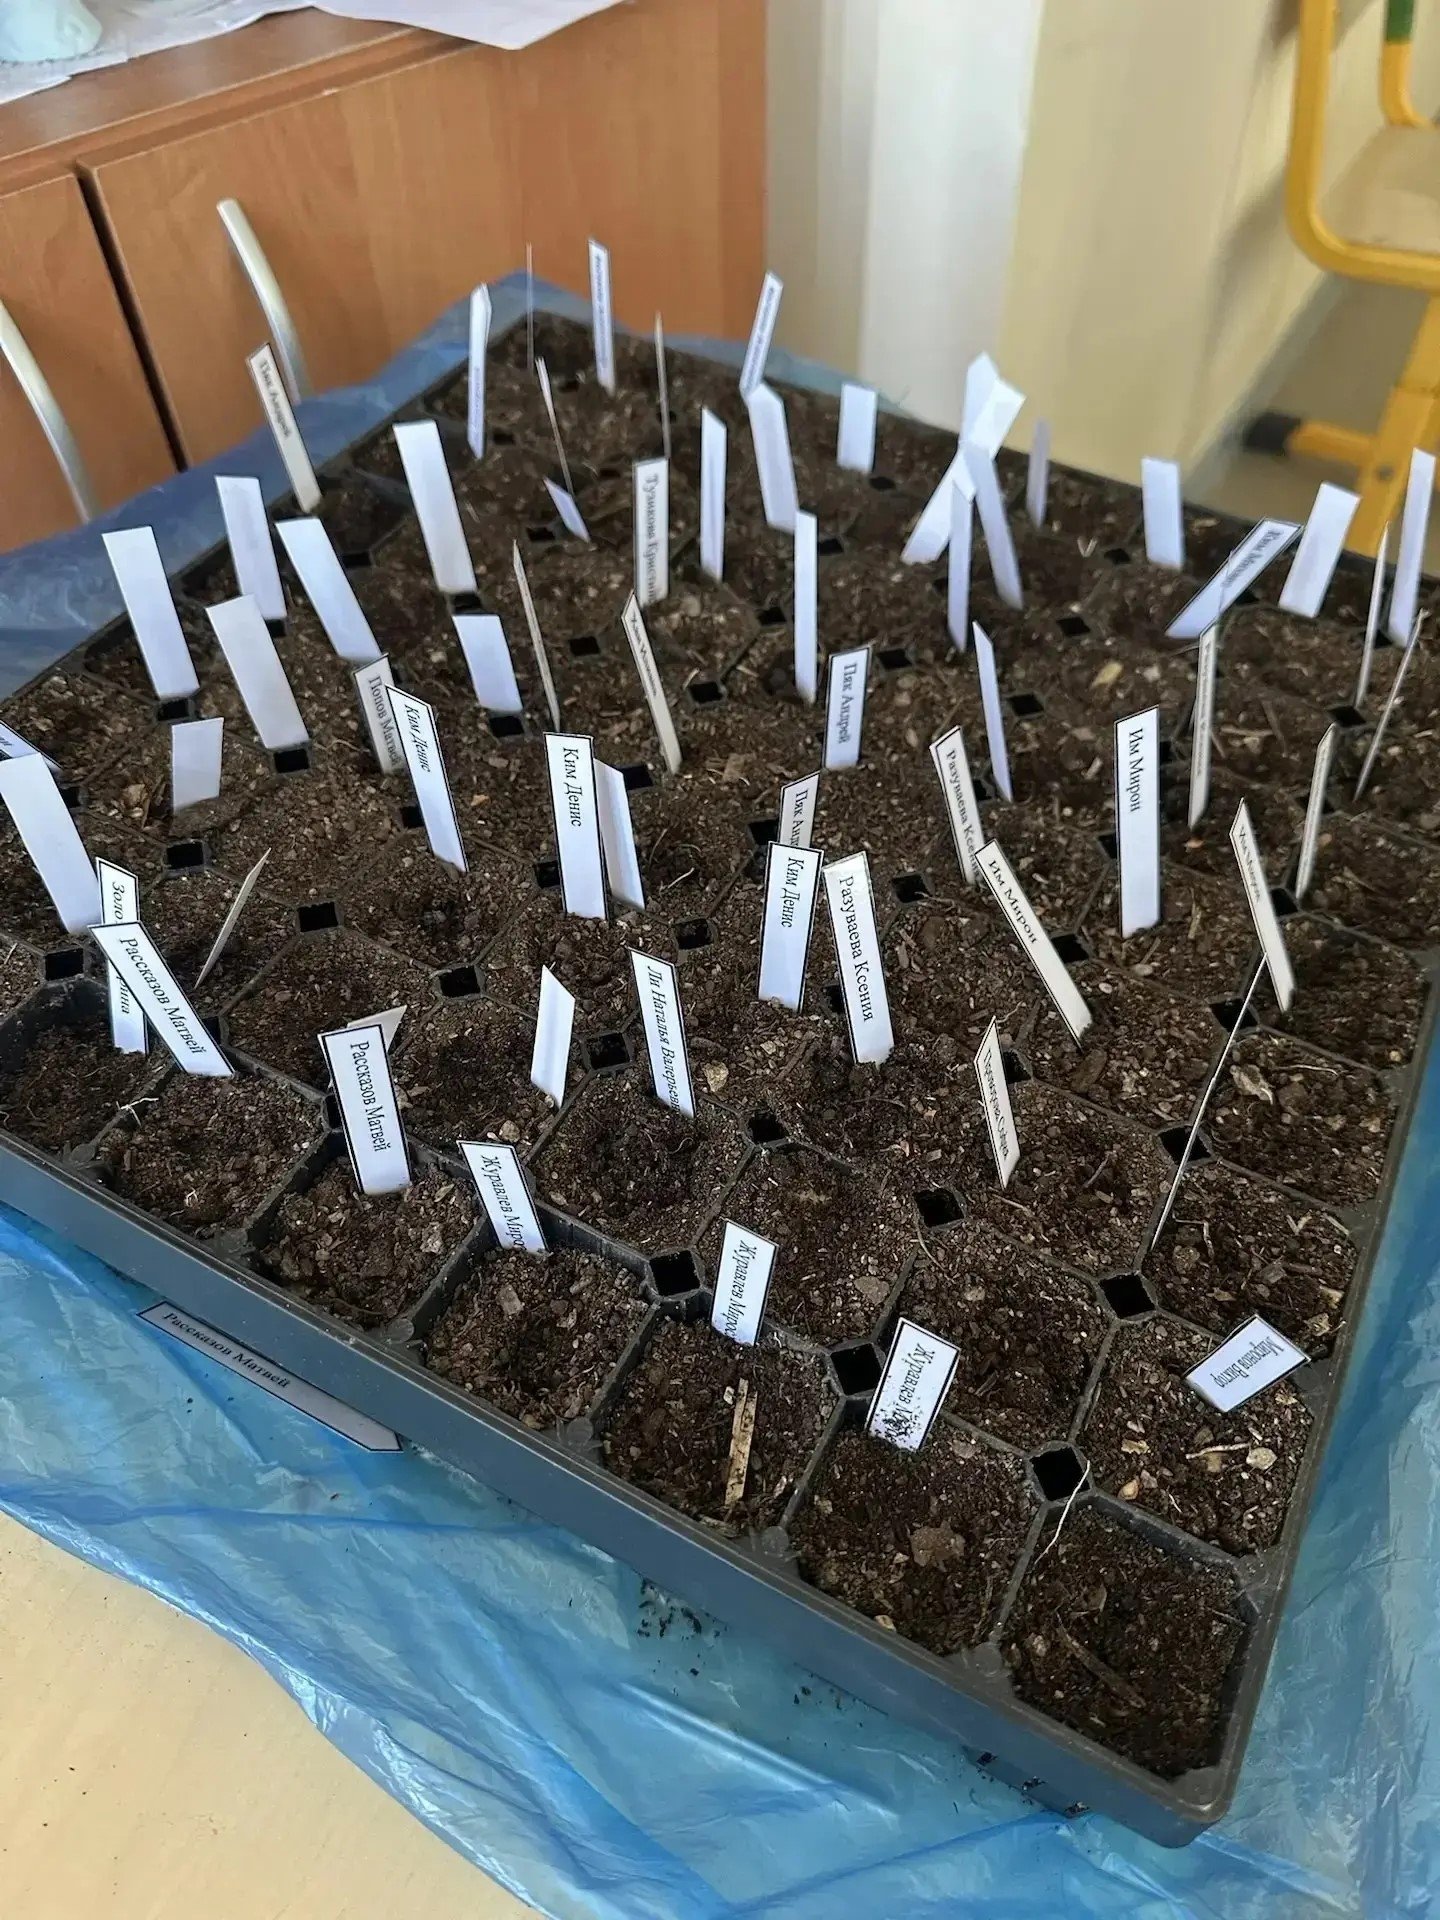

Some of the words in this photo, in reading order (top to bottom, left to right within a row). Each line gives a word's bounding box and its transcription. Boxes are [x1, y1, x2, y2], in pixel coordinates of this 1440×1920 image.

[368, 675, 388, 719] Попов
[842, 663, 858, 691] Пяк
[404, 703, 421, 736] Ким
[838, 696, 853, 744] Андрей
[1128, 728, 1144, 756] Им
[410, 733, 431, 773] Денис
[562, 747, 579, 779] Ким
[563, 782, 583, 828] Денис
[794, 789, 808, 817] Пяк
[945, 749, 969, 824] Разуваева
[1125, 756, 1145, 813] Мирон
[786, 856, 804, 887] Ким
[112, 880, 125, 923] Золо
[780, 886, 801, 928] Денис
[988, 860, 1005, 888] Им
[1004, 888, 1038, 944] Мирон
[838, 875, 863, 960] Разуваева
[854, 960, 875, 1023] Ксения
[119, 937, 170, 1005] Рассказов
[163, 1004, 207, 1055] Матвей
[647, 964, 663, 988] Ли
[651, 990, 670, 1046] Наталья
[350, 1040, 377, 1105] Рассказов
[365, 1105, 392, 1152] Матвей
[480, 1154, 513, 1213] Журавлев
[731, 1239, 758, 1299] Журавлев
[162, 1311, 231, 1356] Рассказов
[233, 1352, 292, 1389] Матвей
[1237, 1336, 1285, 1370] Миронов
[898, 1342, 936, 1404] Журавлев
[1209, 1362, 1250, 1388] Виктор
